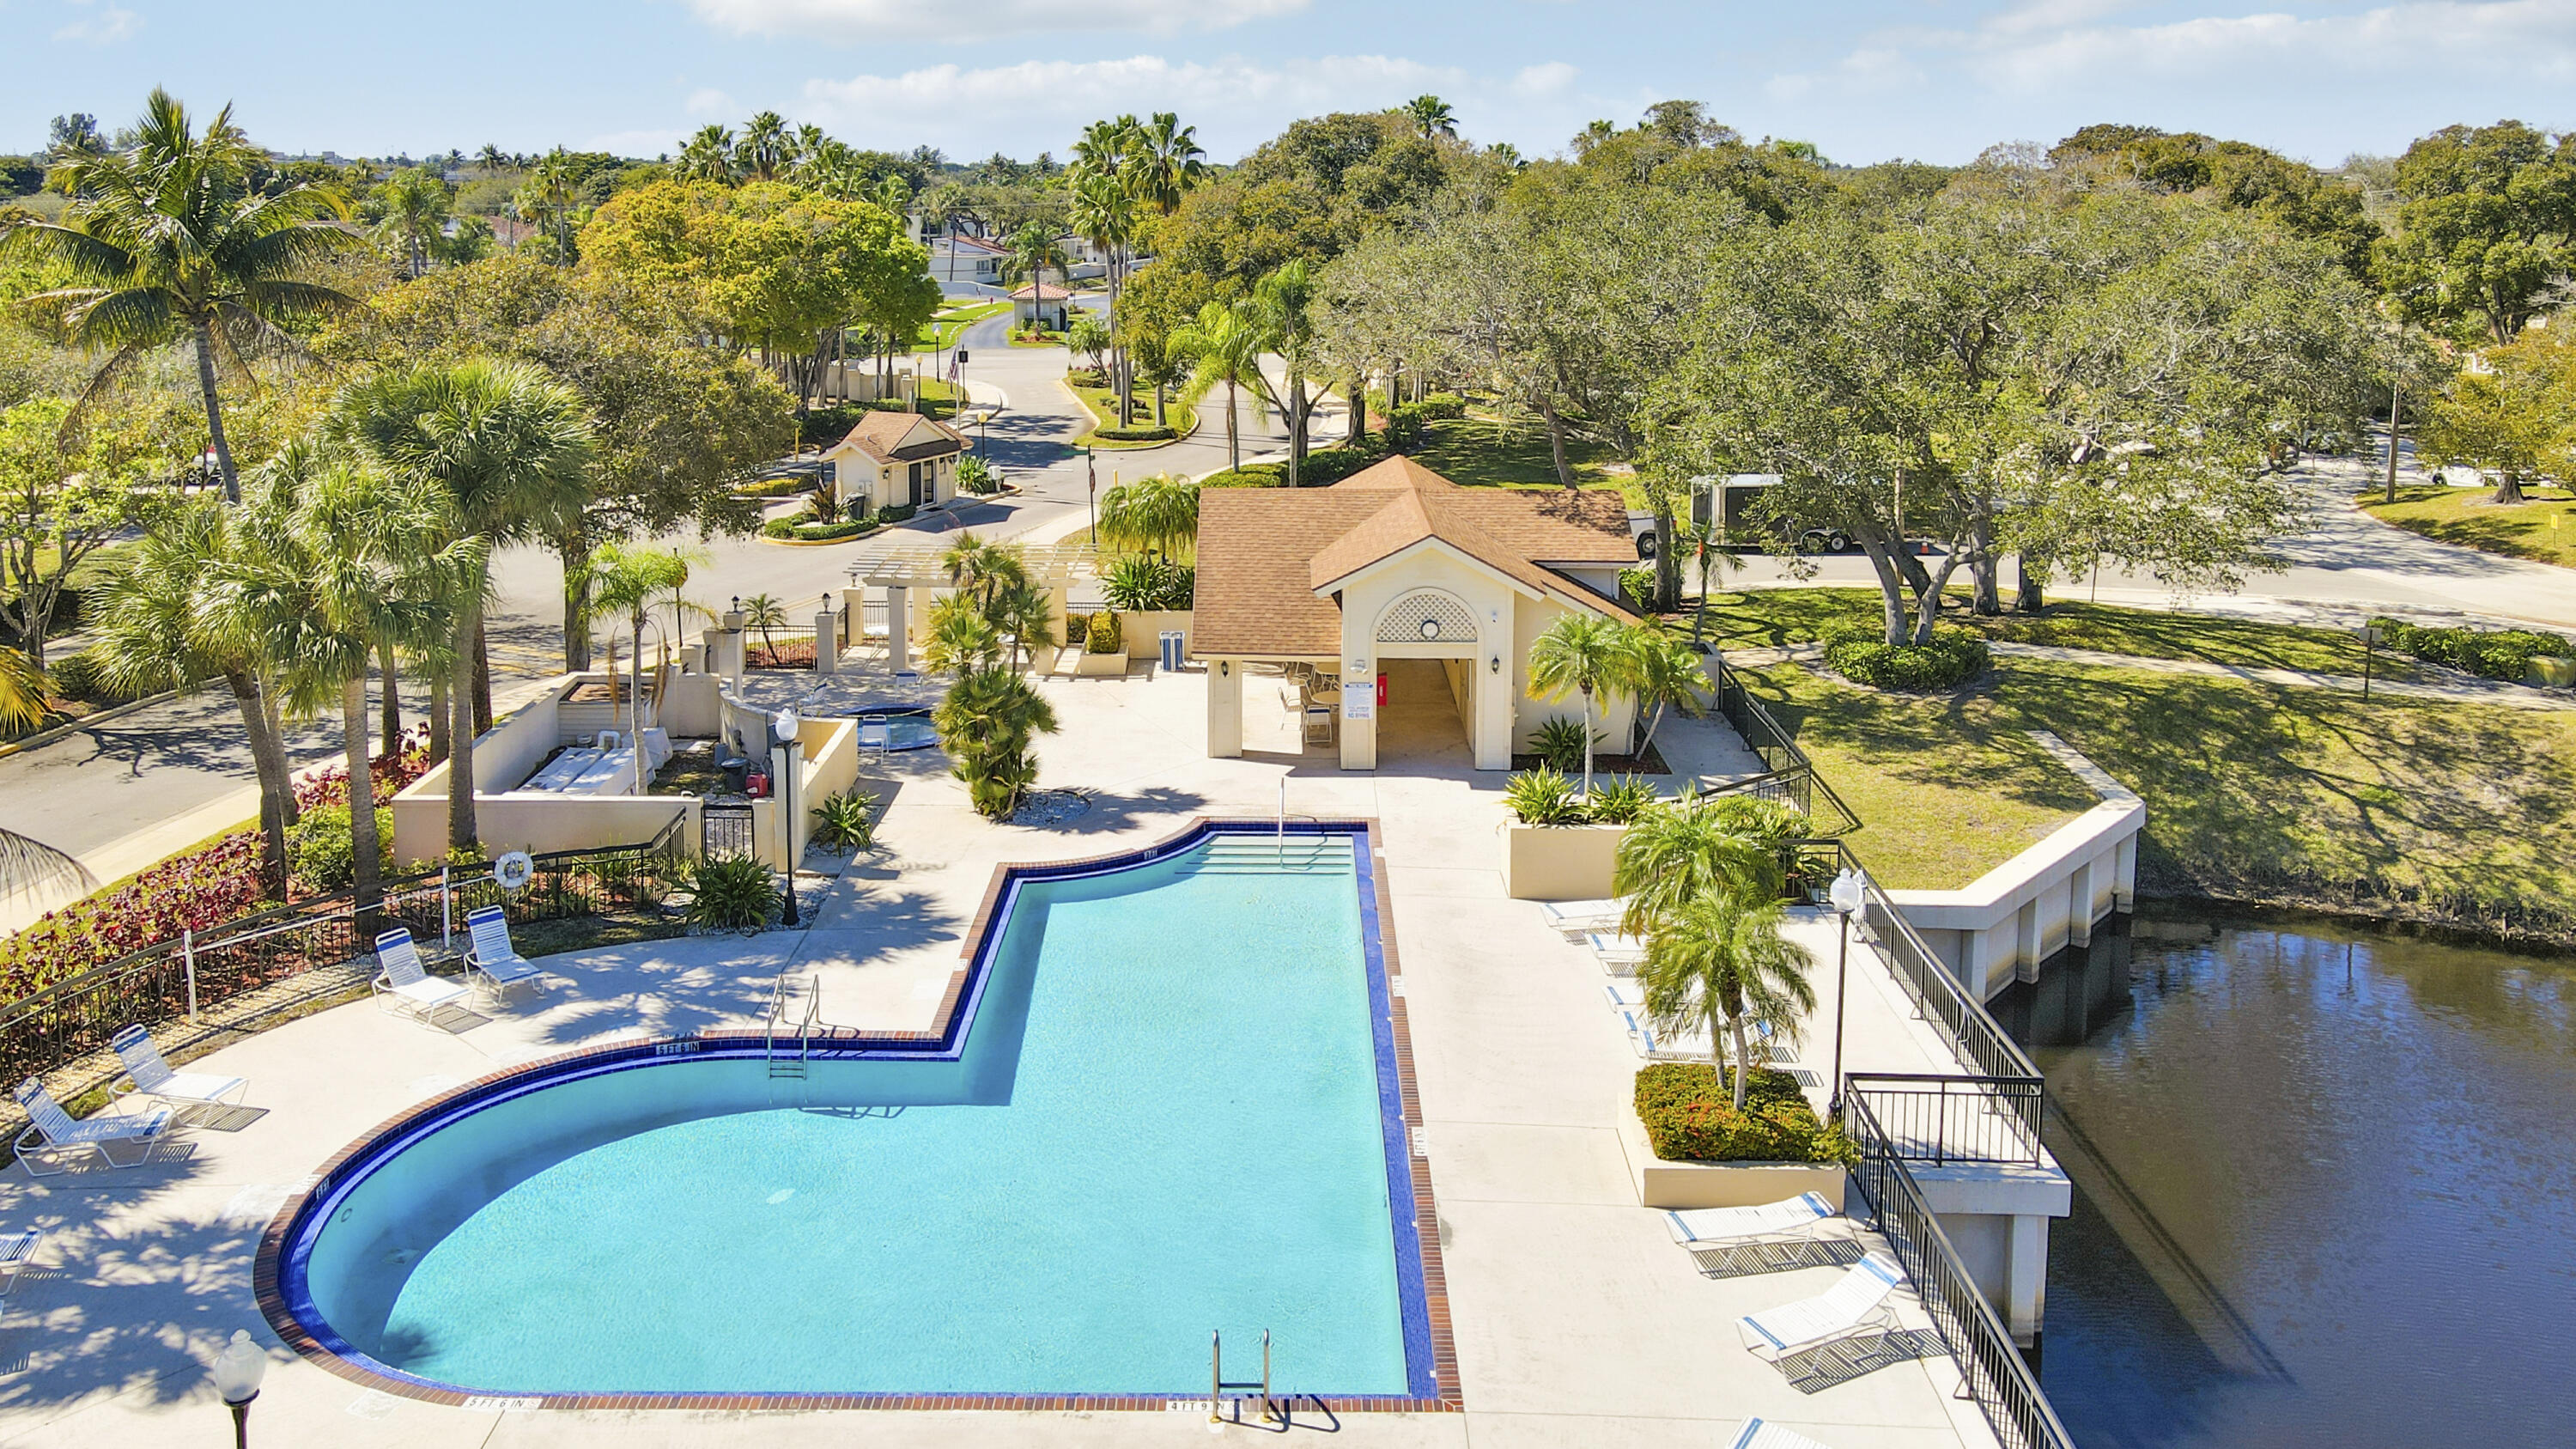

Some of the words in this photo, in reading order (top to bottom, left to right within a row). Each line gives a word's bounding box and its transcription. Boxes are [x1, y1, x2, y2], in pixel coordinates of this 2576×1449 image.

[689, 1042, 698, 1051] IN
[469, 1397, 477, 1407] 5
[480, 1398, 496, 1407] FT
[500, 1399, 507, 1408] 6
[511, 1399, 525, 1408] IN
[1171, 1402, 1177, 1410] 4
